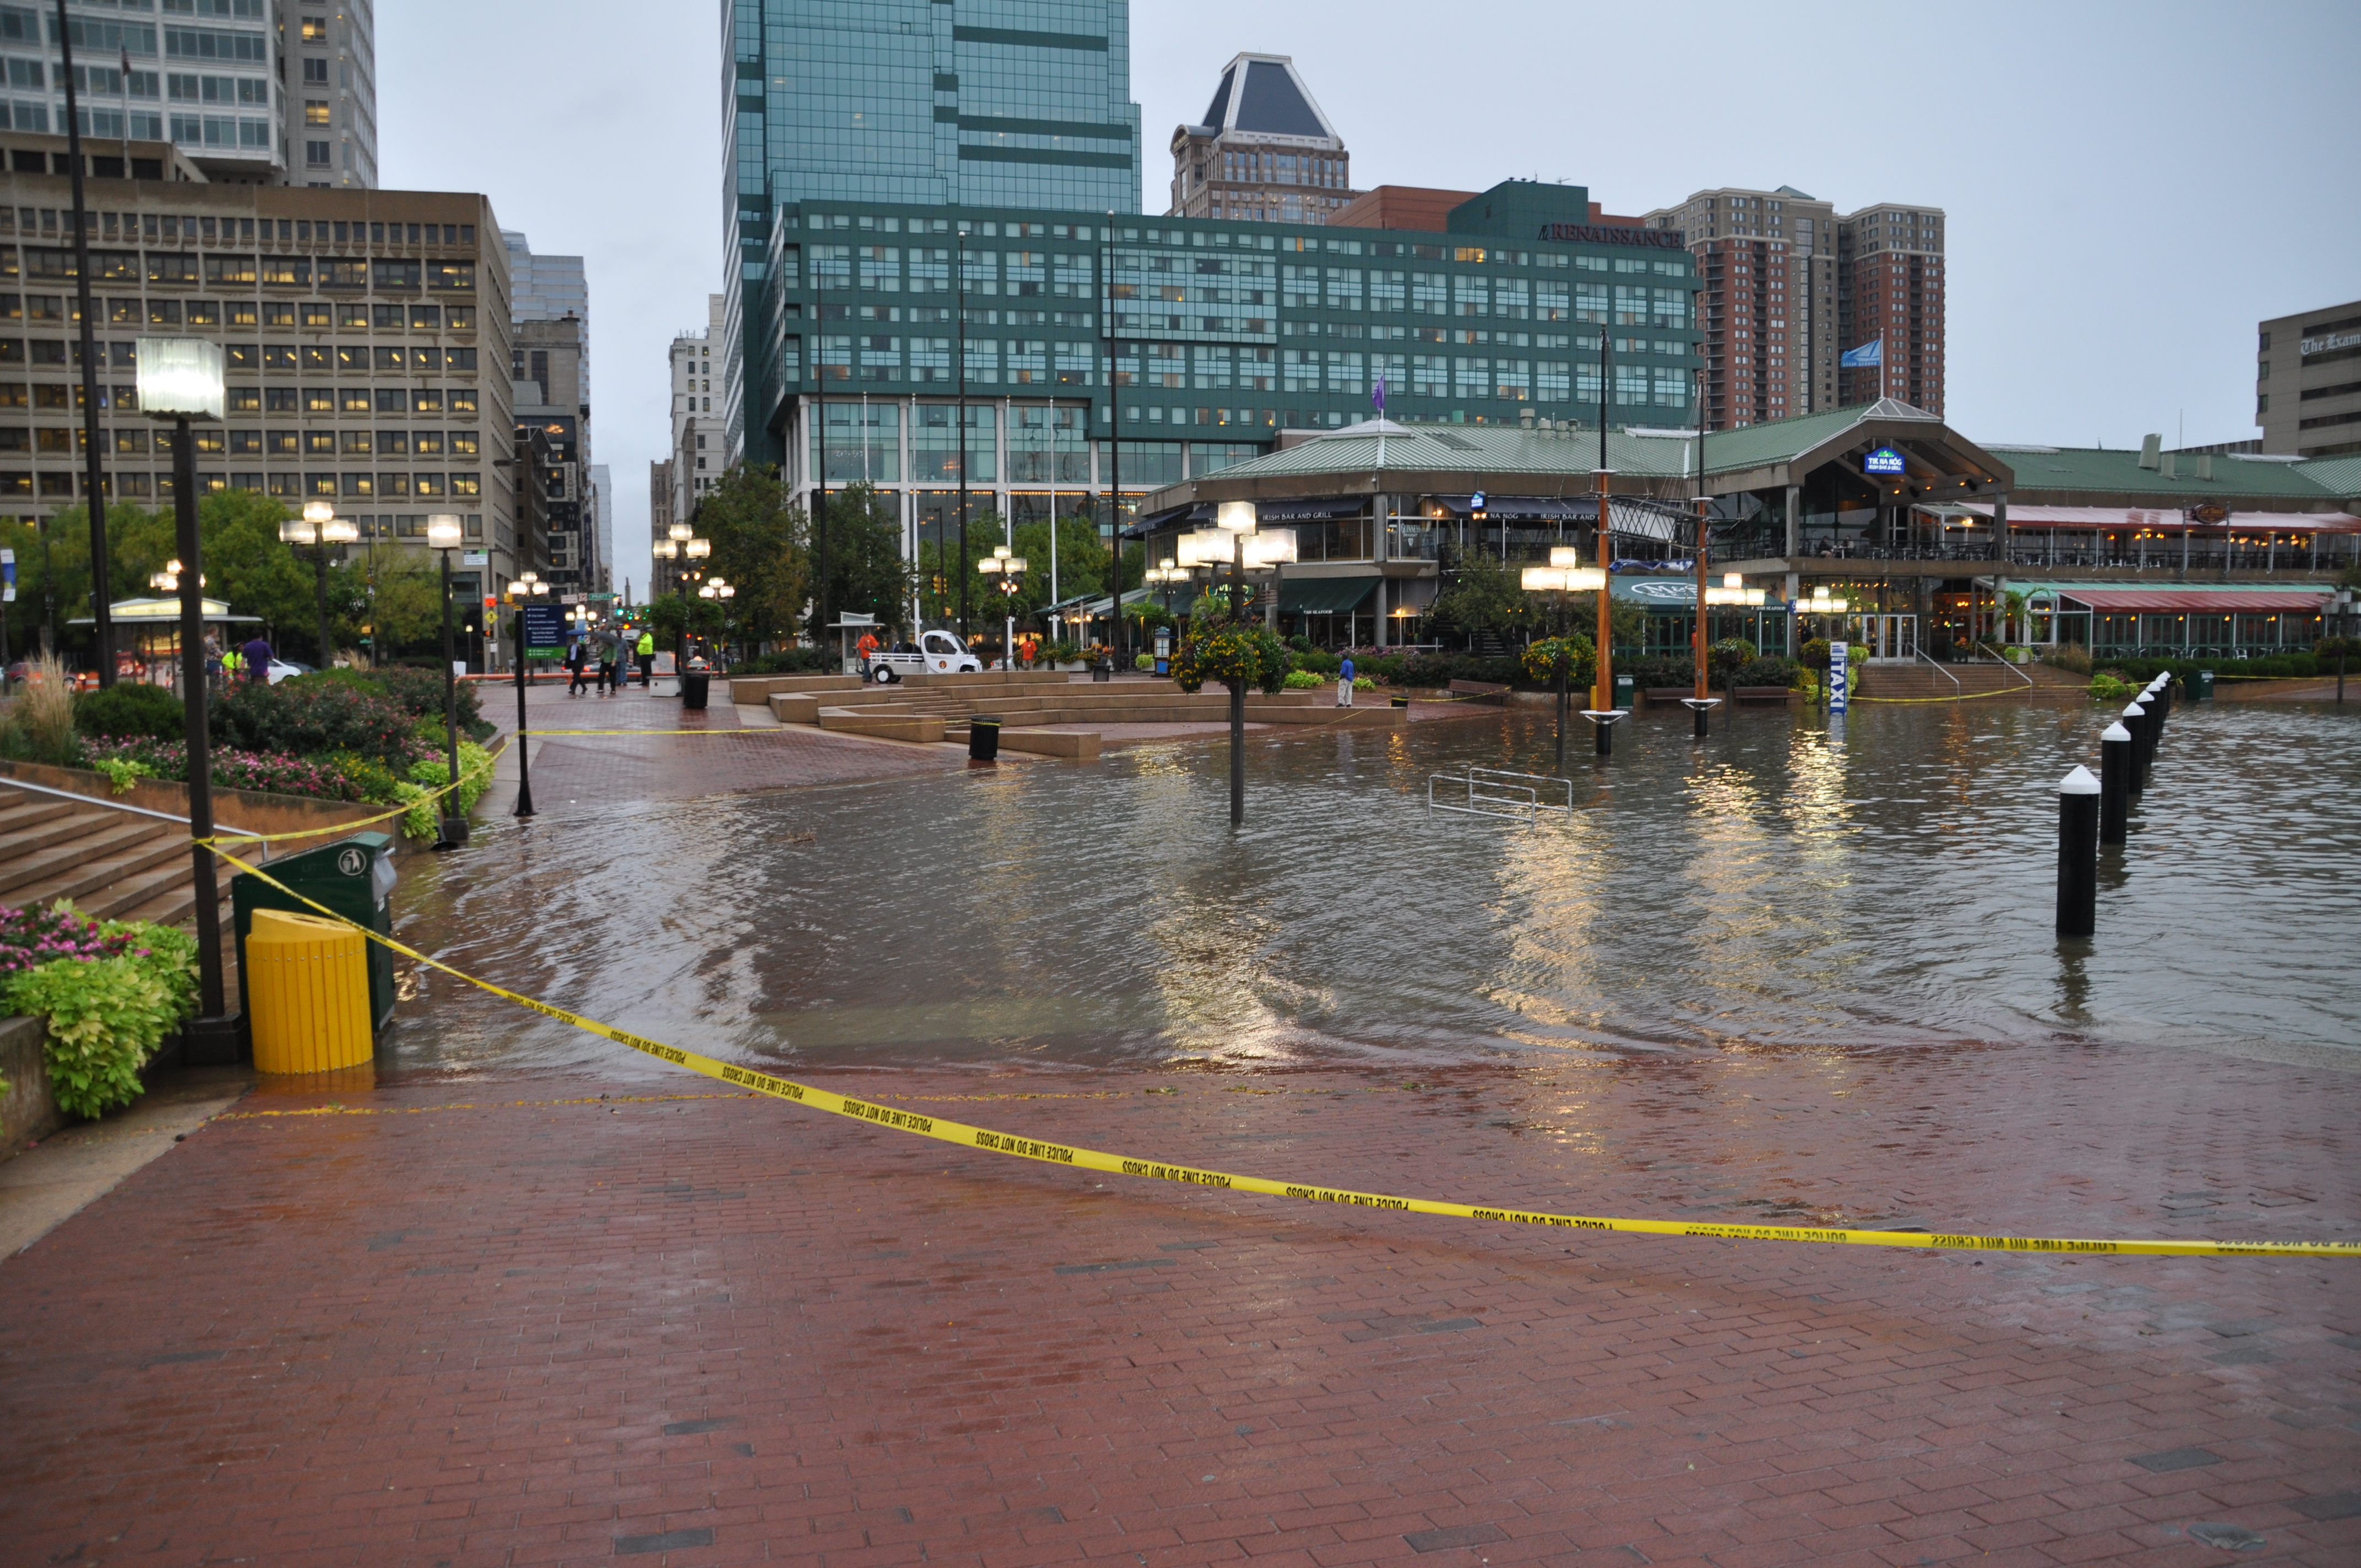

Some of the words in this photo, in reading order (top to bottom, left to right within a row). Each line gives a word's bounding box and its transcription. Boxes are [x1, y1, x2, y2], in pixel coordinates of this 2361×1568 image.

[1552, 222, 1683, 248] RENAISSANCE
[2301, 338, 2324, 355] The
[1830, 662, 1845, 707] TAXI
[610, 1031, 628, 1043] CROSS
[630, 1038, 641, 1047] NOT
[641, 1041, 650, 1051] DO
[651, 1044, 664, 1055] LINE
[665, 1048, 686, 1063] POLICE
[722, 1066, 742, 1081] CROSS
[742, 1073, 755, 1085] NOT
[757, 1076, 766, 1088] DO
[766, 1079, 780, 1092] LINE
[781, 1083, 803, 1099] POLICE
[842, 1101, 864, 1116] CROSS
[865, 1106, 879, 1119] NOT
[880, 1109, 890, 1123] DO
[890, 1112, 906, 1126] LINE
[907, 1116, 932, 1132] POLICE
[976, 1132, 999, 1148] CROSS
[1000, 1137, 1015, 1151] NOT
[1016, 1140, 1027, 1154] DO
[1029, 1142, 1045, 1157] LINE
[1047, 1146, 1073, 1162] POLICE
[1122, 1161, 1148, 1176] CROSS
[1150, 1164, 1166, 1179] NOT
[1167, 1167, 1179, 1181] DO
[1181, 1170, 1199, 1183] LINE
[1201, 1173, 1231, 1188] POLICE
